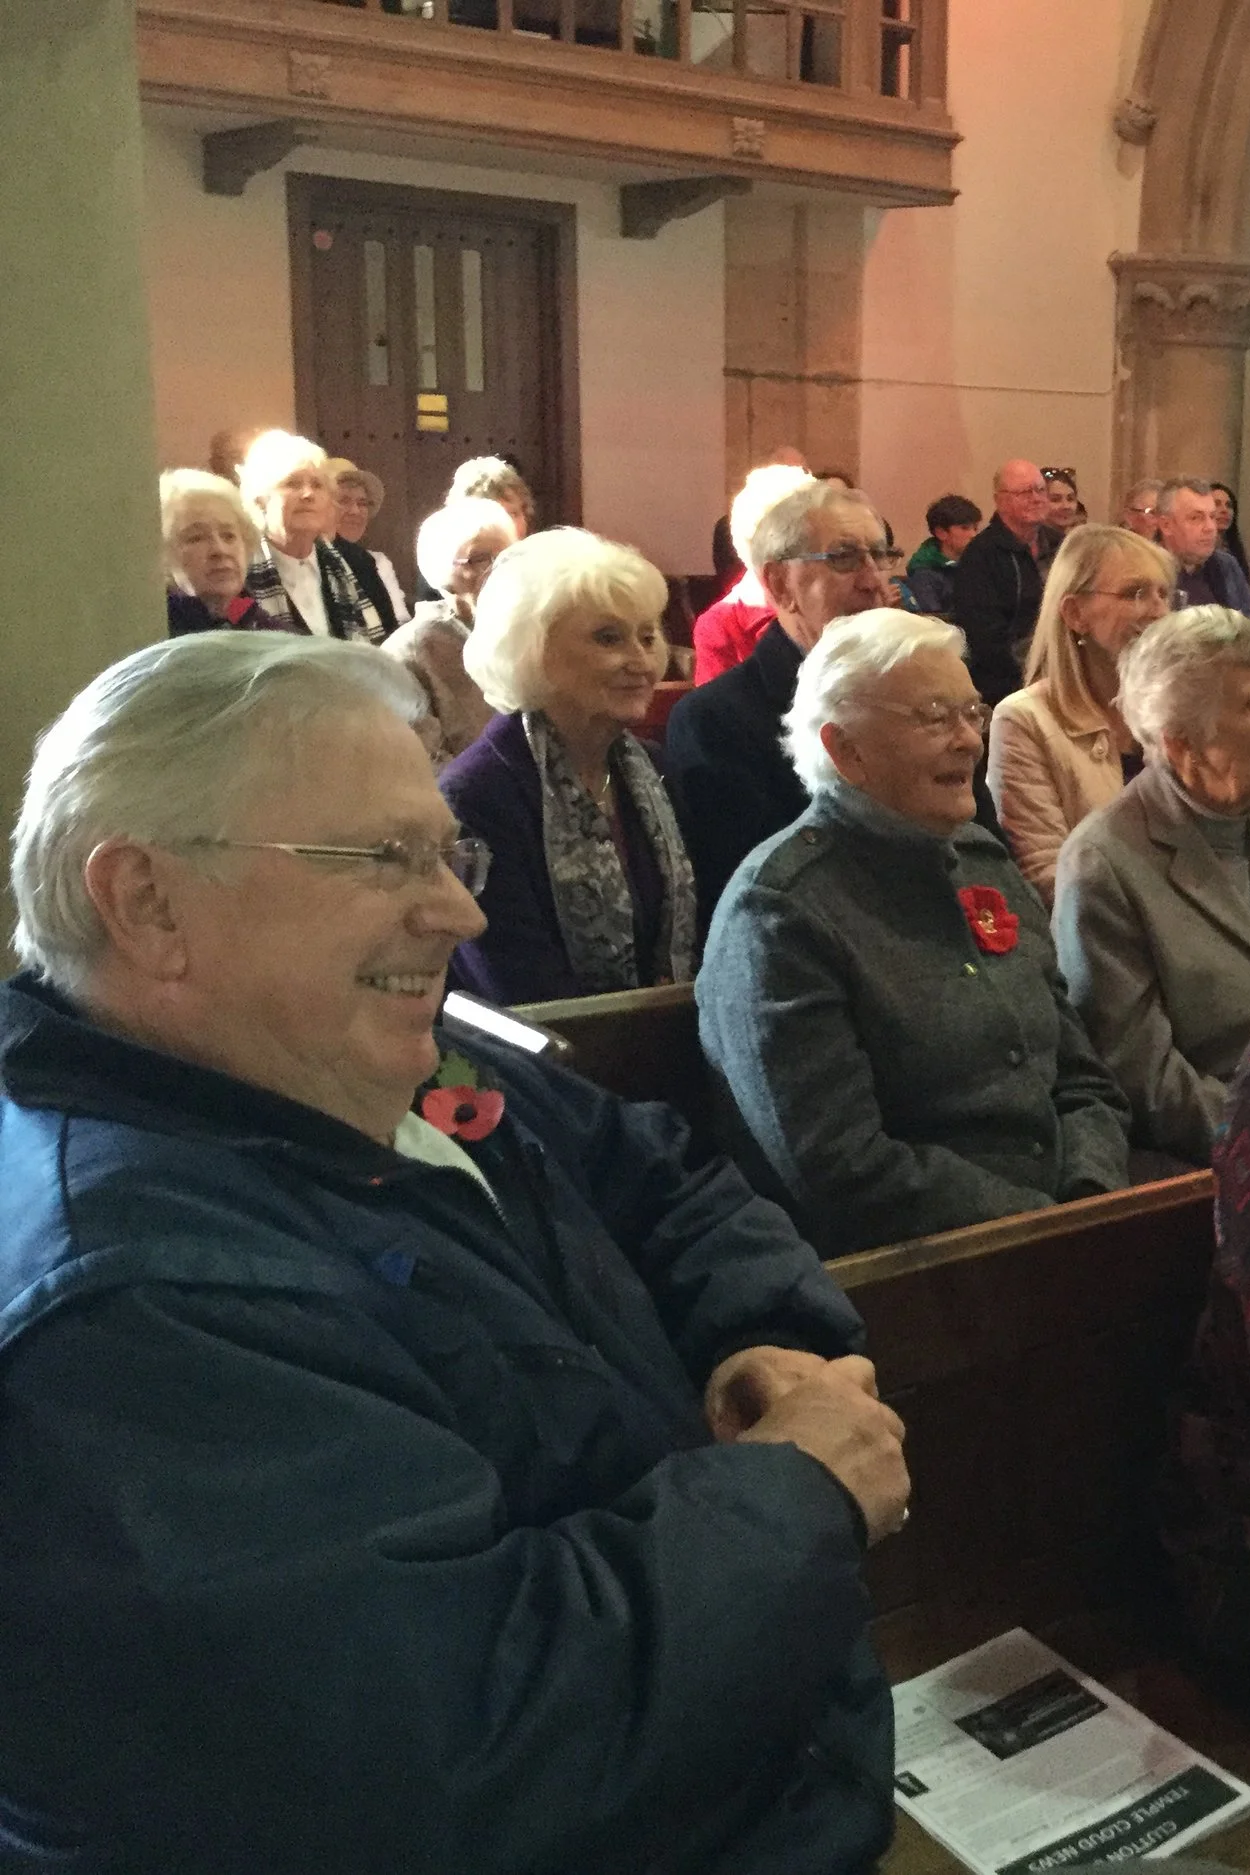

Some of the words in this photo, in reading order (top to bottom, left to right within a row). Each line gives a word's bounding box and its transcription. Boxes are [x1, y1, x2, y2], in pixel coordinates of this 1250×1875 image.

[1130, 1785, 1189, 1824] TEMPLE
[1077, 1819, 1132, 1851] CLOUD
[1105, 1820, 1177, 1863] CLUTTON
[1028, 1844, 1079, 1873] NEWS
